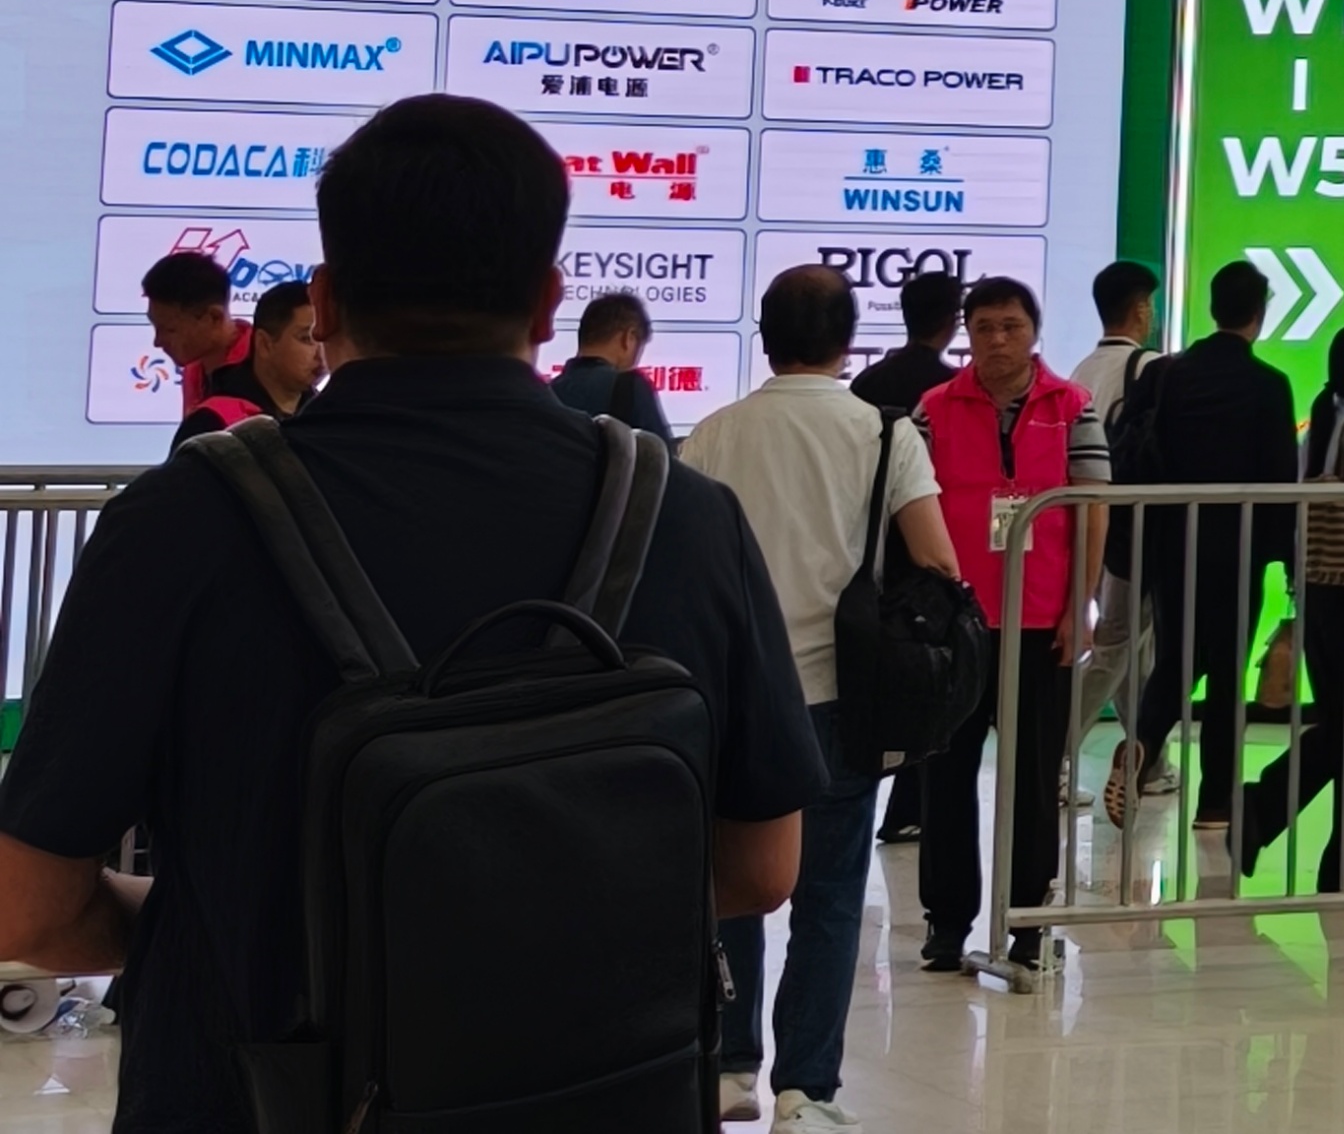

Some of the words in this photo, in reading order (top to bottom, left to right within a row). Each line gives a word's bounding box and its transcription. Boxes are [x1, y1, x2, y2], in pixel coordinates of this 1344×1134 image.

[245, 39, 384, 71] MINMAX
[541, 74, 649, 97] 爱浦电源
[816, 65, 916, 87] TRACO
[923, 69, 1025, 91] POWER
[143, 141, 289, 178] CODACA
[612, 150, 698, 175] Wall
[863, 148, 944, 176] 惠桑
[844, 187, 964, 214] WINSUN
